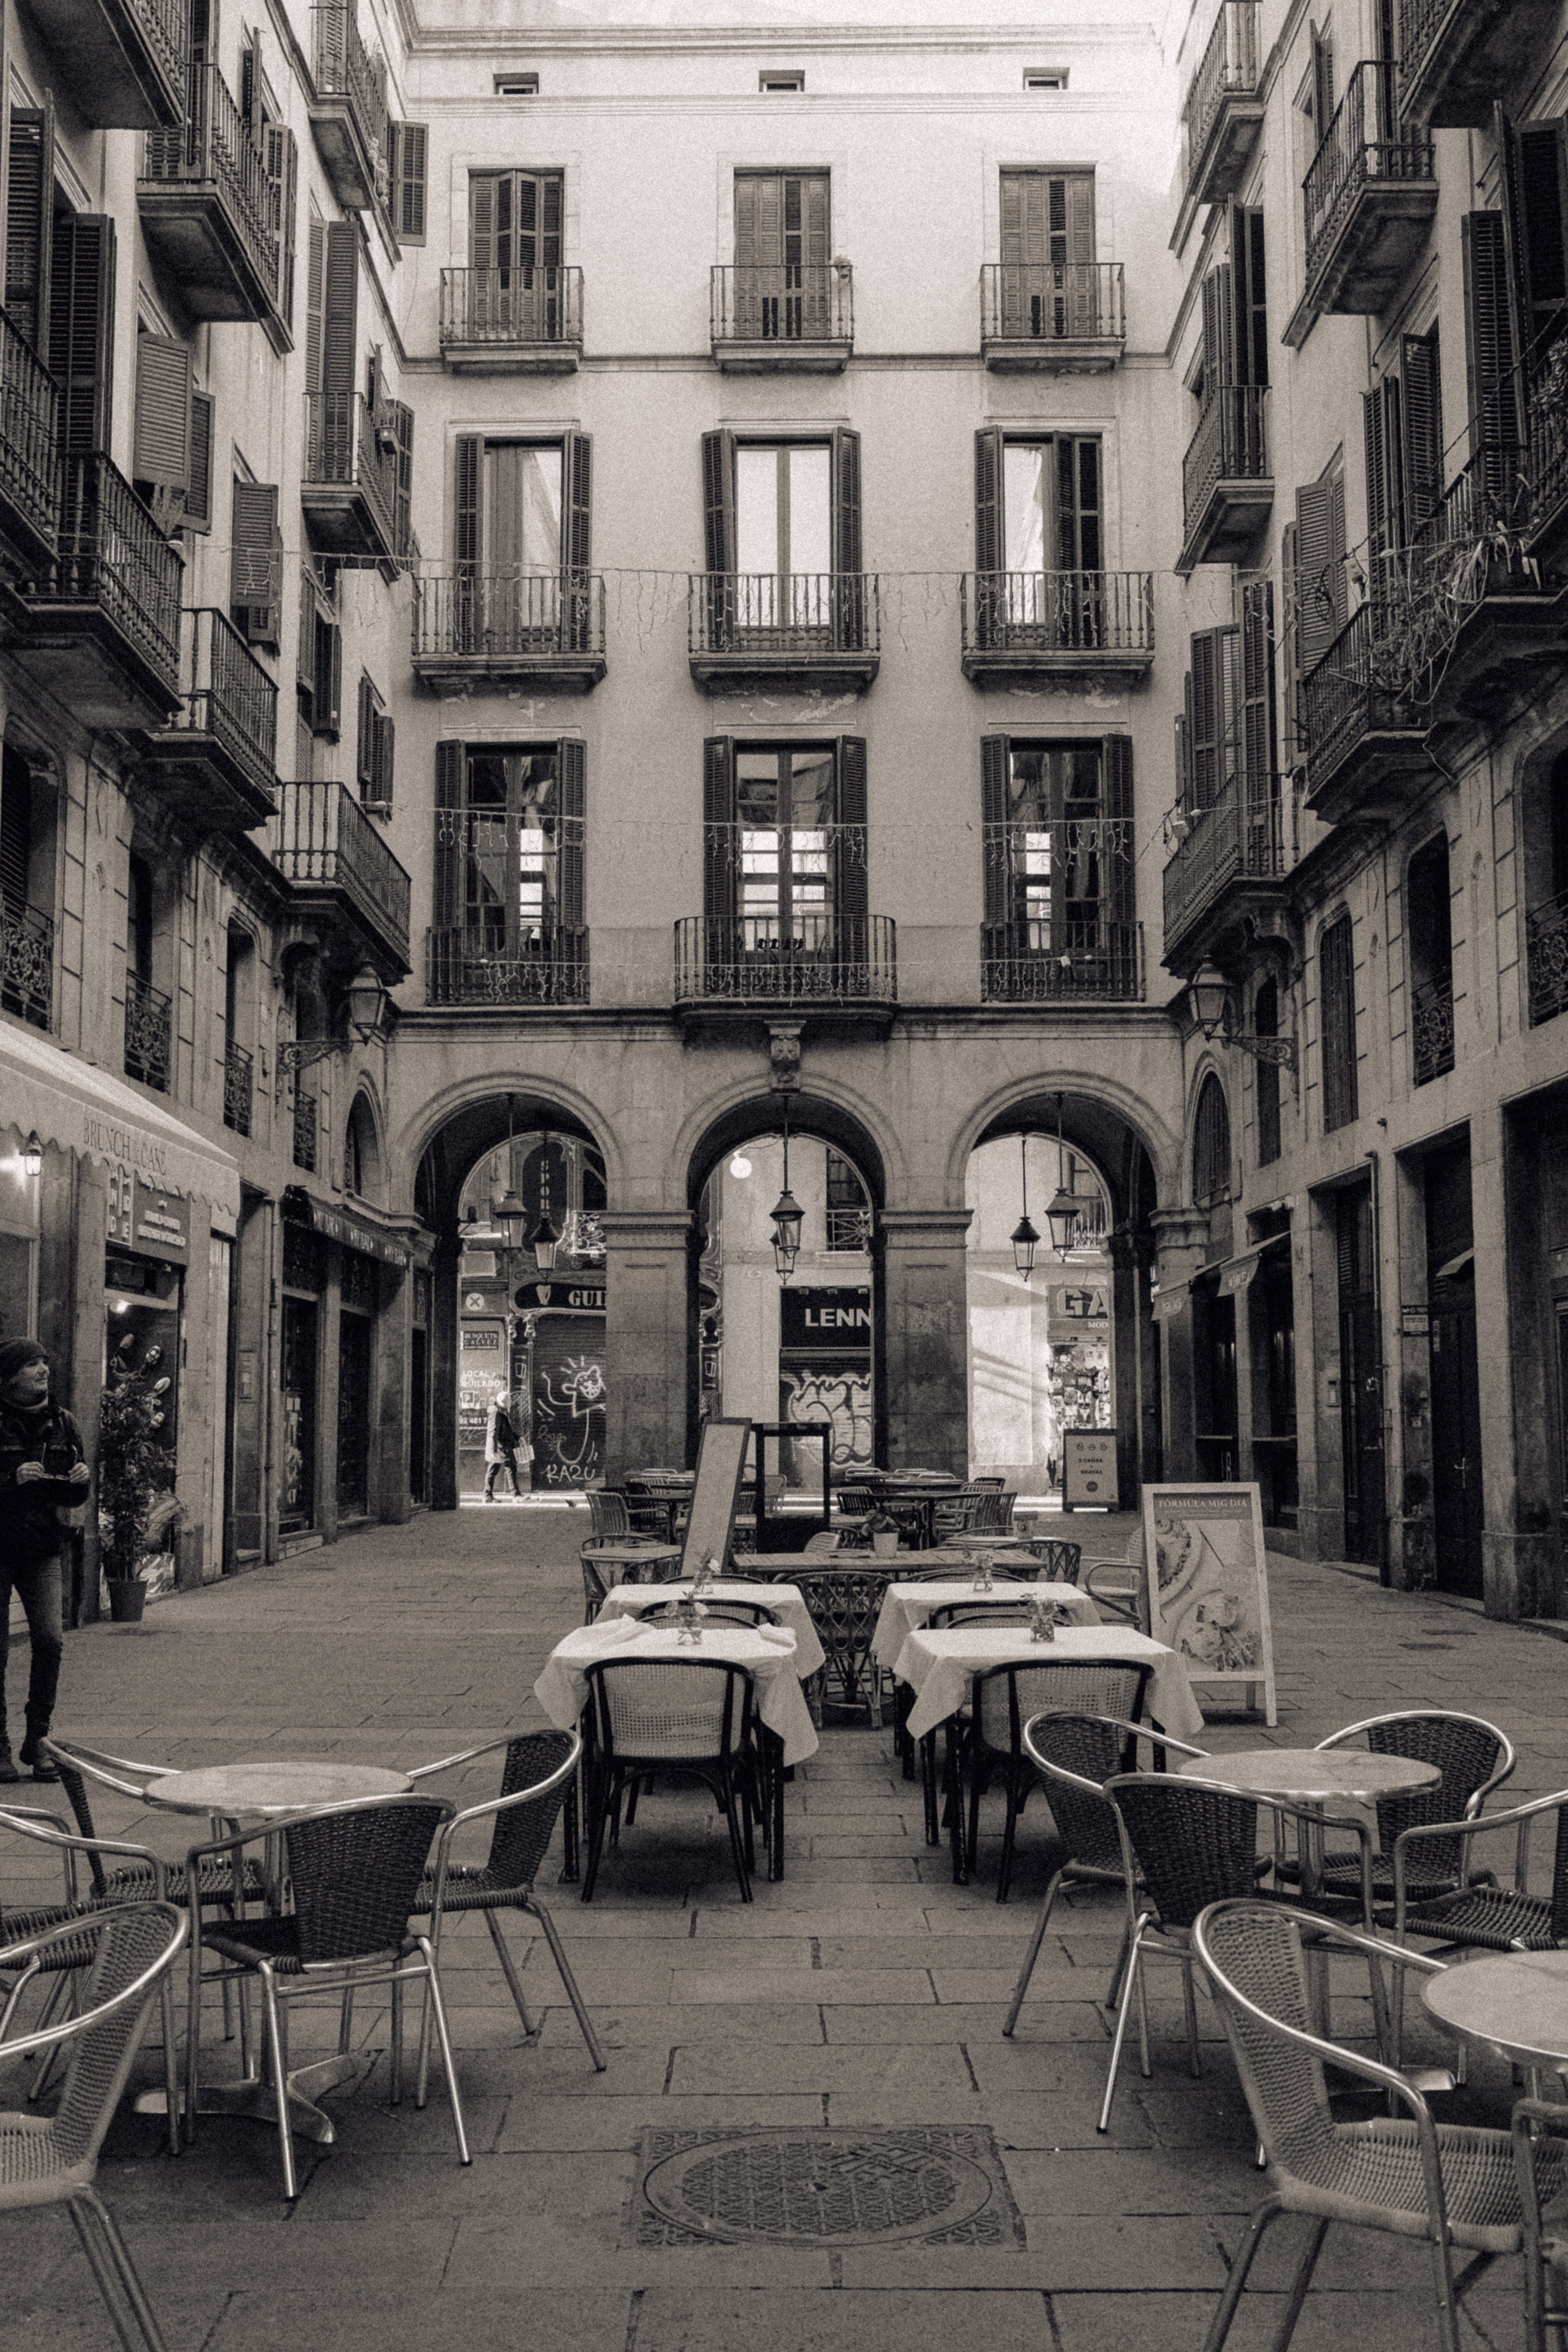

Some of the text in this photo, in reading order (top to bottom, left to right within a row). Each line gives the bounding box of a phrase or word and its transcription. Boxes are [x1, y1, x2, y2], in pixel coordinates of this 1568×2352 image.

[83, 1117, 131, 1162] BRUNCH
[568, 1290, 606, 1306] GUI
[1056, 1288, 1108, 1316] GA
[805, 1308, 871, 1327] LENN
